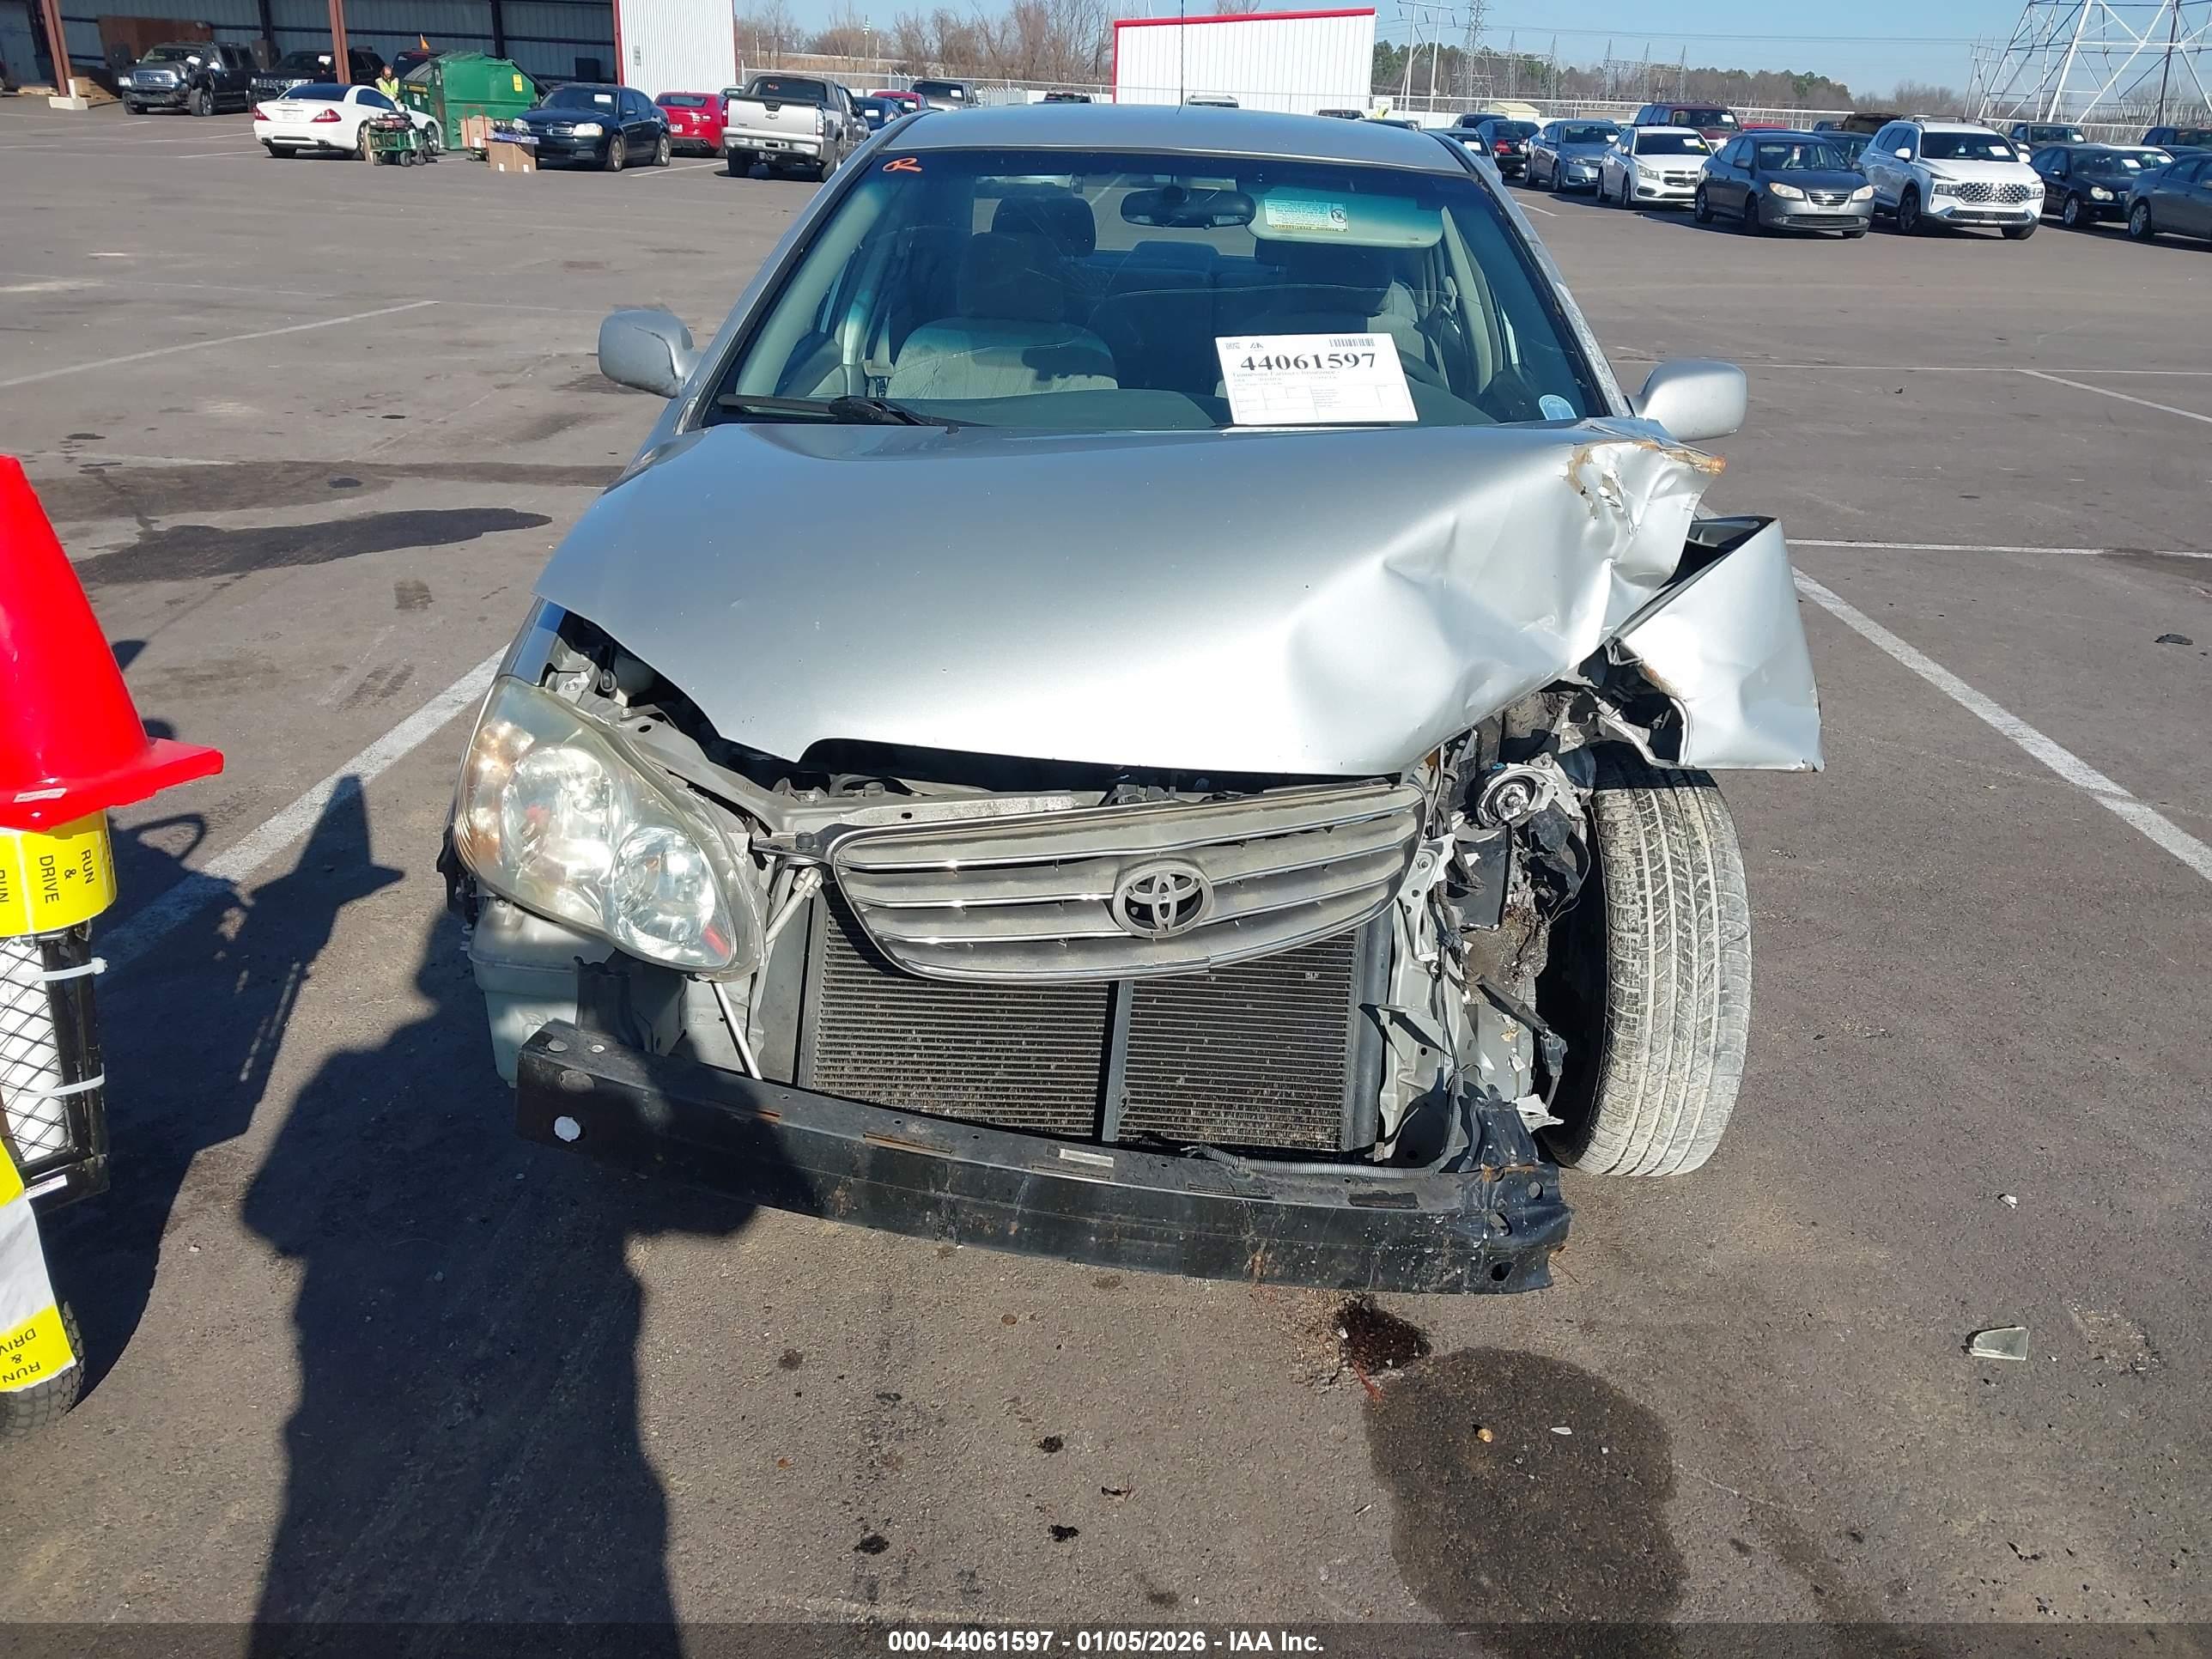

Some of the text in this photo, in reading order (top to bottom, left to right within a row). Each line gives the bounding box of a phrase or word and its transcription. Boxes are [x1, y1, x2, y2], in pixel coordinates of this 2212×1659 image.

[1240, 352, 1376, 371] 44061597
[64, 868, 76, 880] &
[81, 848, 95, 884] RUN
[40, 854, 60, 904] DRIVE
[0, 1328, 37, 1357] DRIV
[9, 1353, 22, 1364] &
[3, 1361, 41, 1383] RUN
